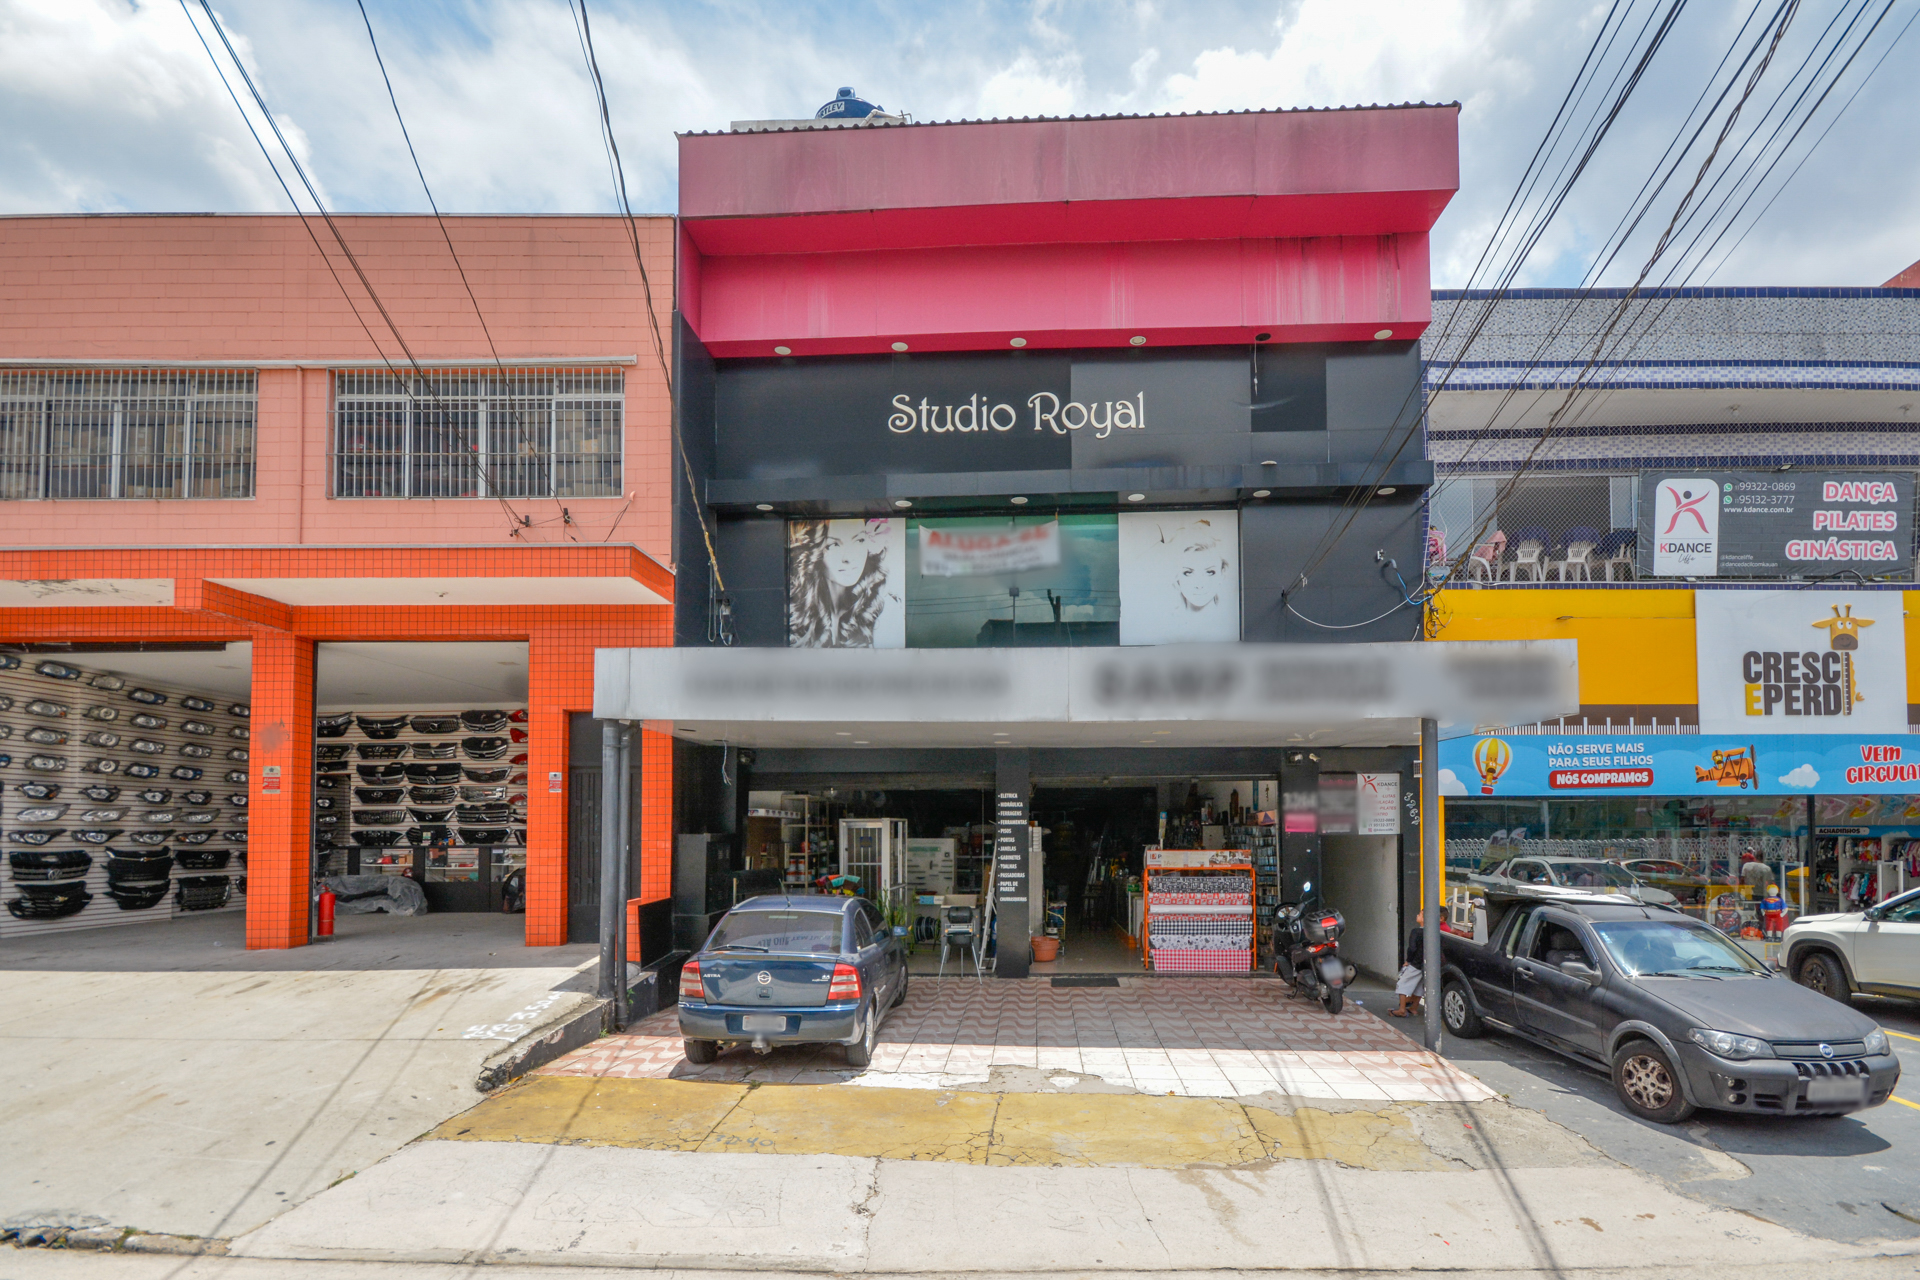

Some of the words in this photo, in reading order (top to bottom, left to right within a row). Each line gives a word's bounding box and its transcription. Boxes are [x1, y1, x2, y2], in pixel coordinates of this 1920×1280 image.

[888, 393, 1017, 433] Studio
[1027, 391, 1146, 438] Royal
[1823, 481, 1898, 504] DANÇA
[1724, 506, 1794, 514] www.kdance.com.br
[1813, 511, 1897, 531] PILATES
[1659, 543, 1713, 553] KDANCE
[1785, 537, 1898, 560] GINÁSTICA
[1547, 743, 1574, 755] NÃO
[1576, 743, 1613, 754] SERVE
[1615, 742, 1645, 753] MAIS
[1860, 744, 1902, 763] VEM
[1548, 758, 1580, 768] PARA
[1582, 756, 1612, 767] SEUS
[1613, 755, 1654, 766] FILHOS
[1556, 772, 1580, 785] NÓS
[1580, 771, 1649, 784] COMPRAMOS
